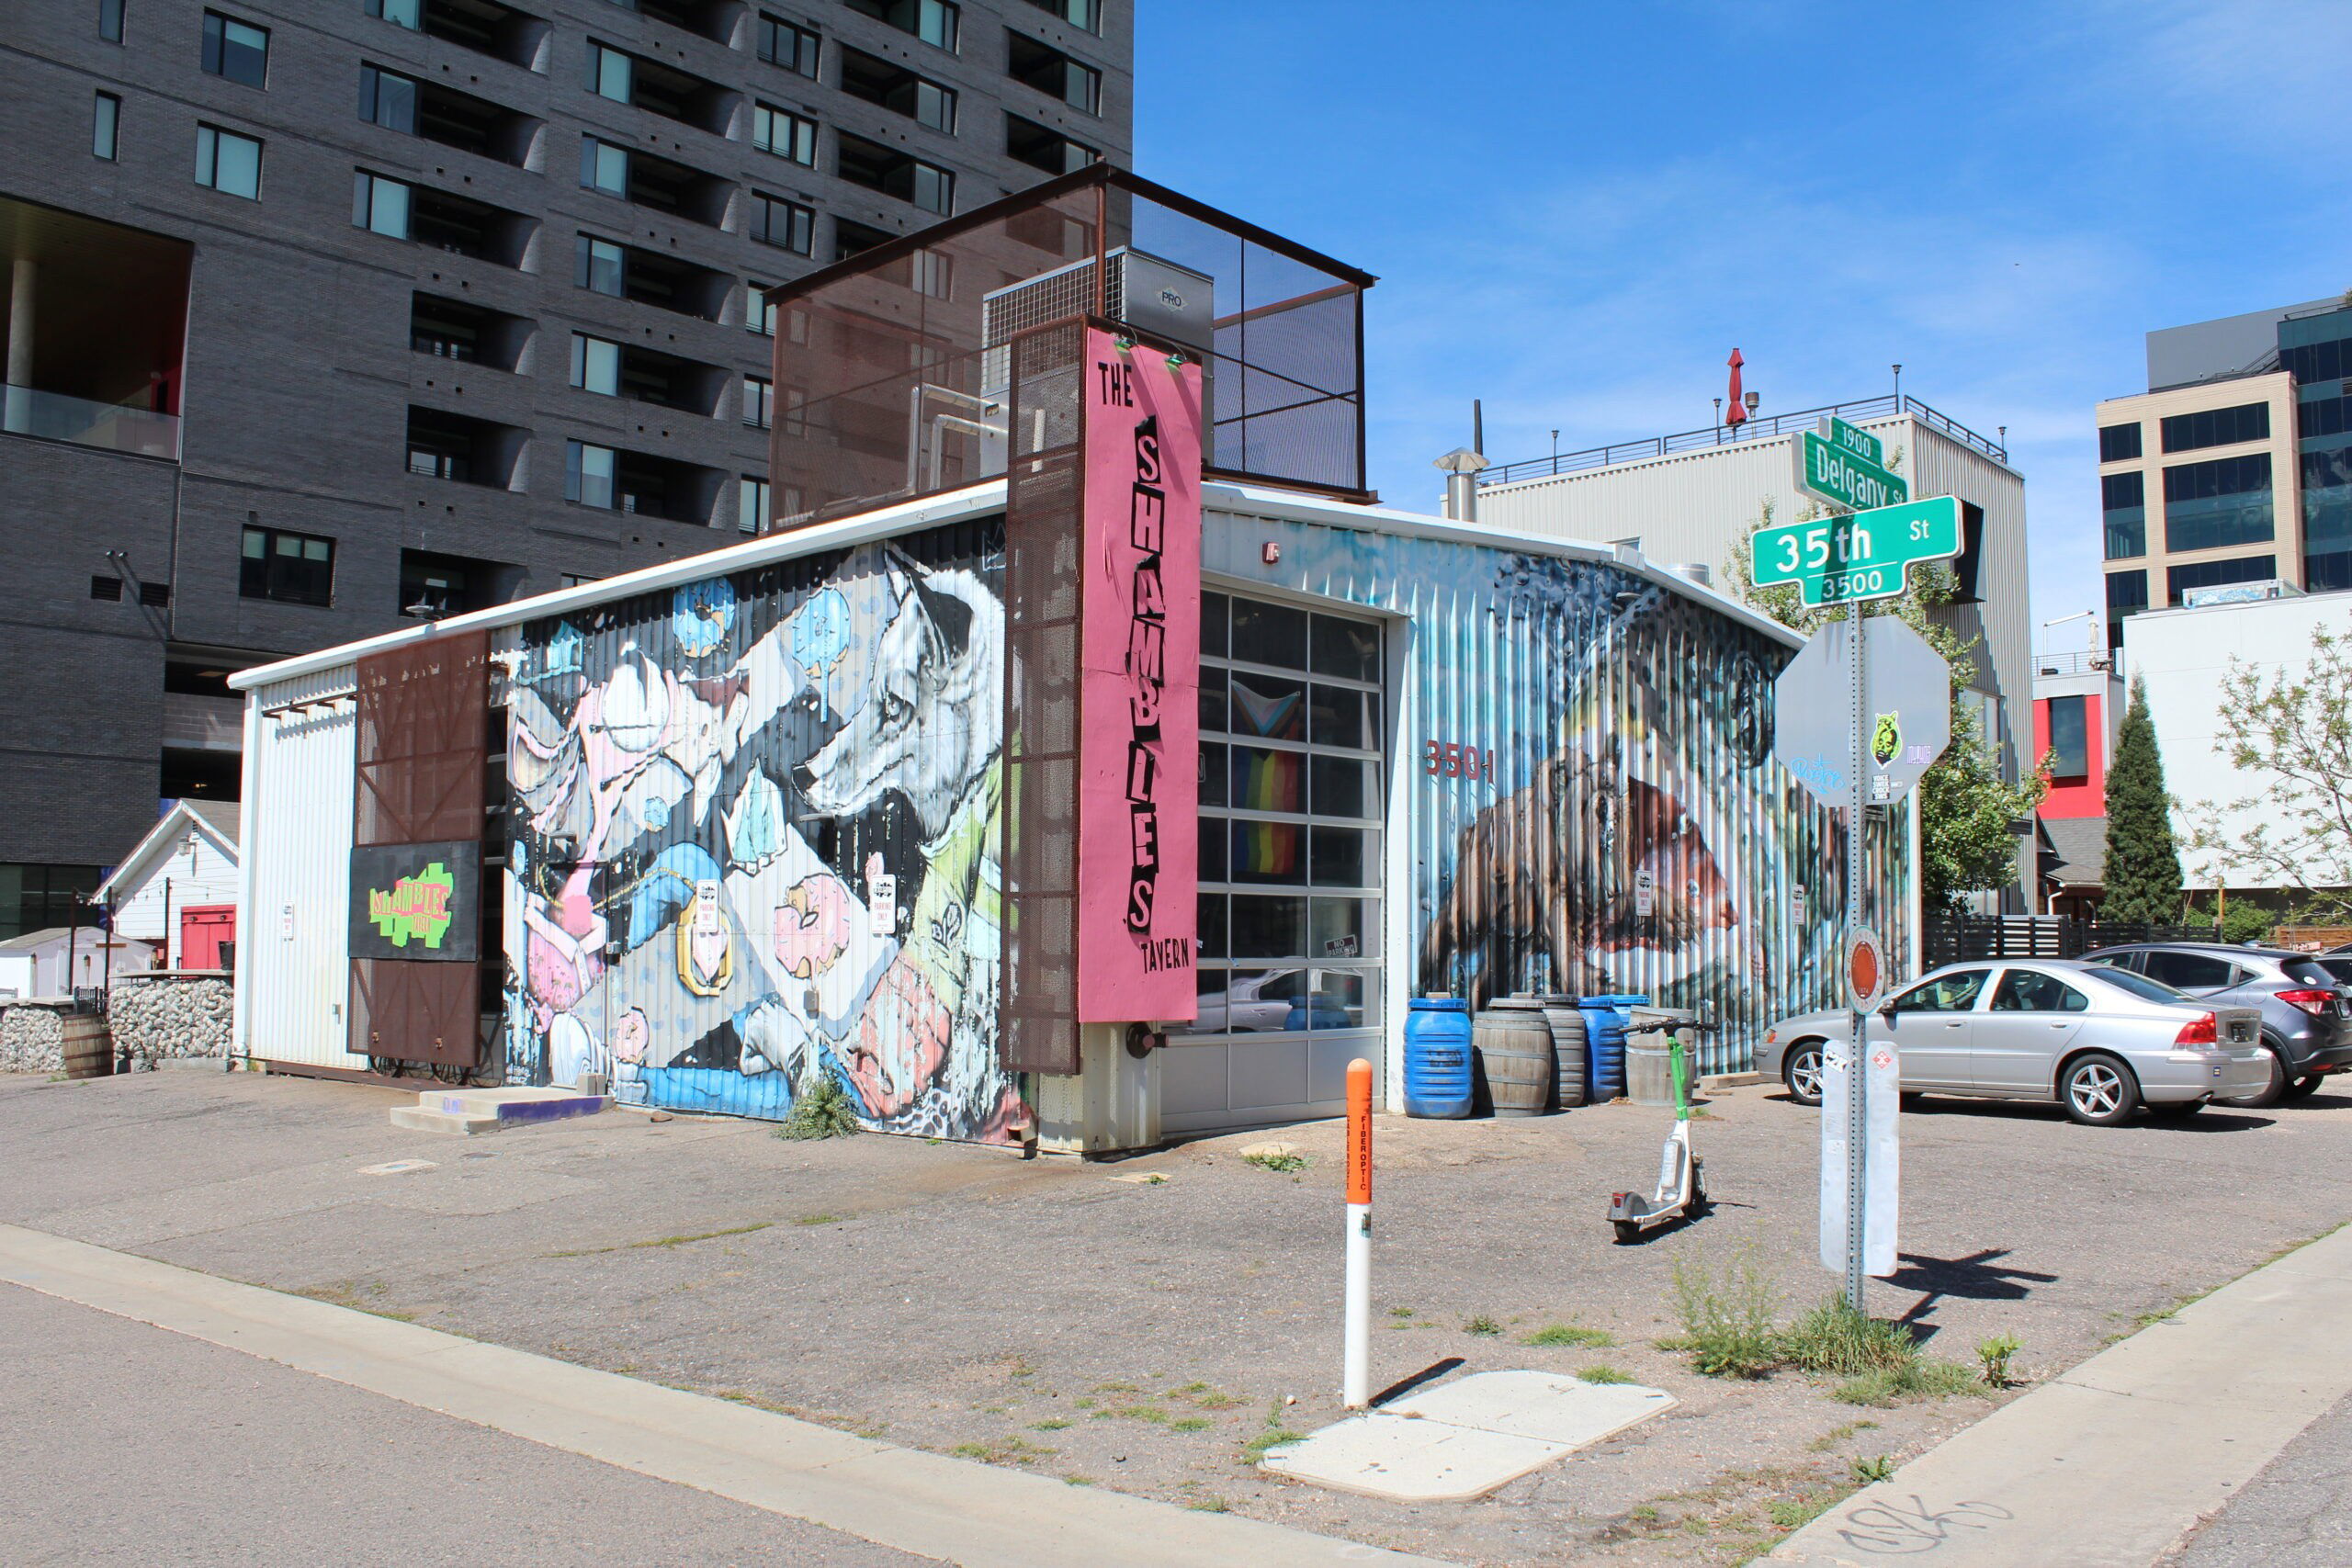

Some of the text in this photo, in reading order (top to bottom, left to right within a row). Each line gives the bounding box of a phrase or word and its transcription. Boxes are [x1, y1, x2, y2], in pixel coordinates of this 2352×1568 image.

[1162, 291, 1182, 307] PRO
[1097, 361, 1134, 409] THE
[1842, 425, 1871, 458] 1900
[1816, 443, 1888, 511] Delgany
[1776, 519, 1930, 573] 35th St
[1822, 570, 1883, 599] 3500
[1125, 415, 1166, 934] SHAMBLES
[1427, 739, 1494, 784] 3501
[1140, 937, 1189, 975] TAVERN
[1333, 939, 1345, 948] NO
